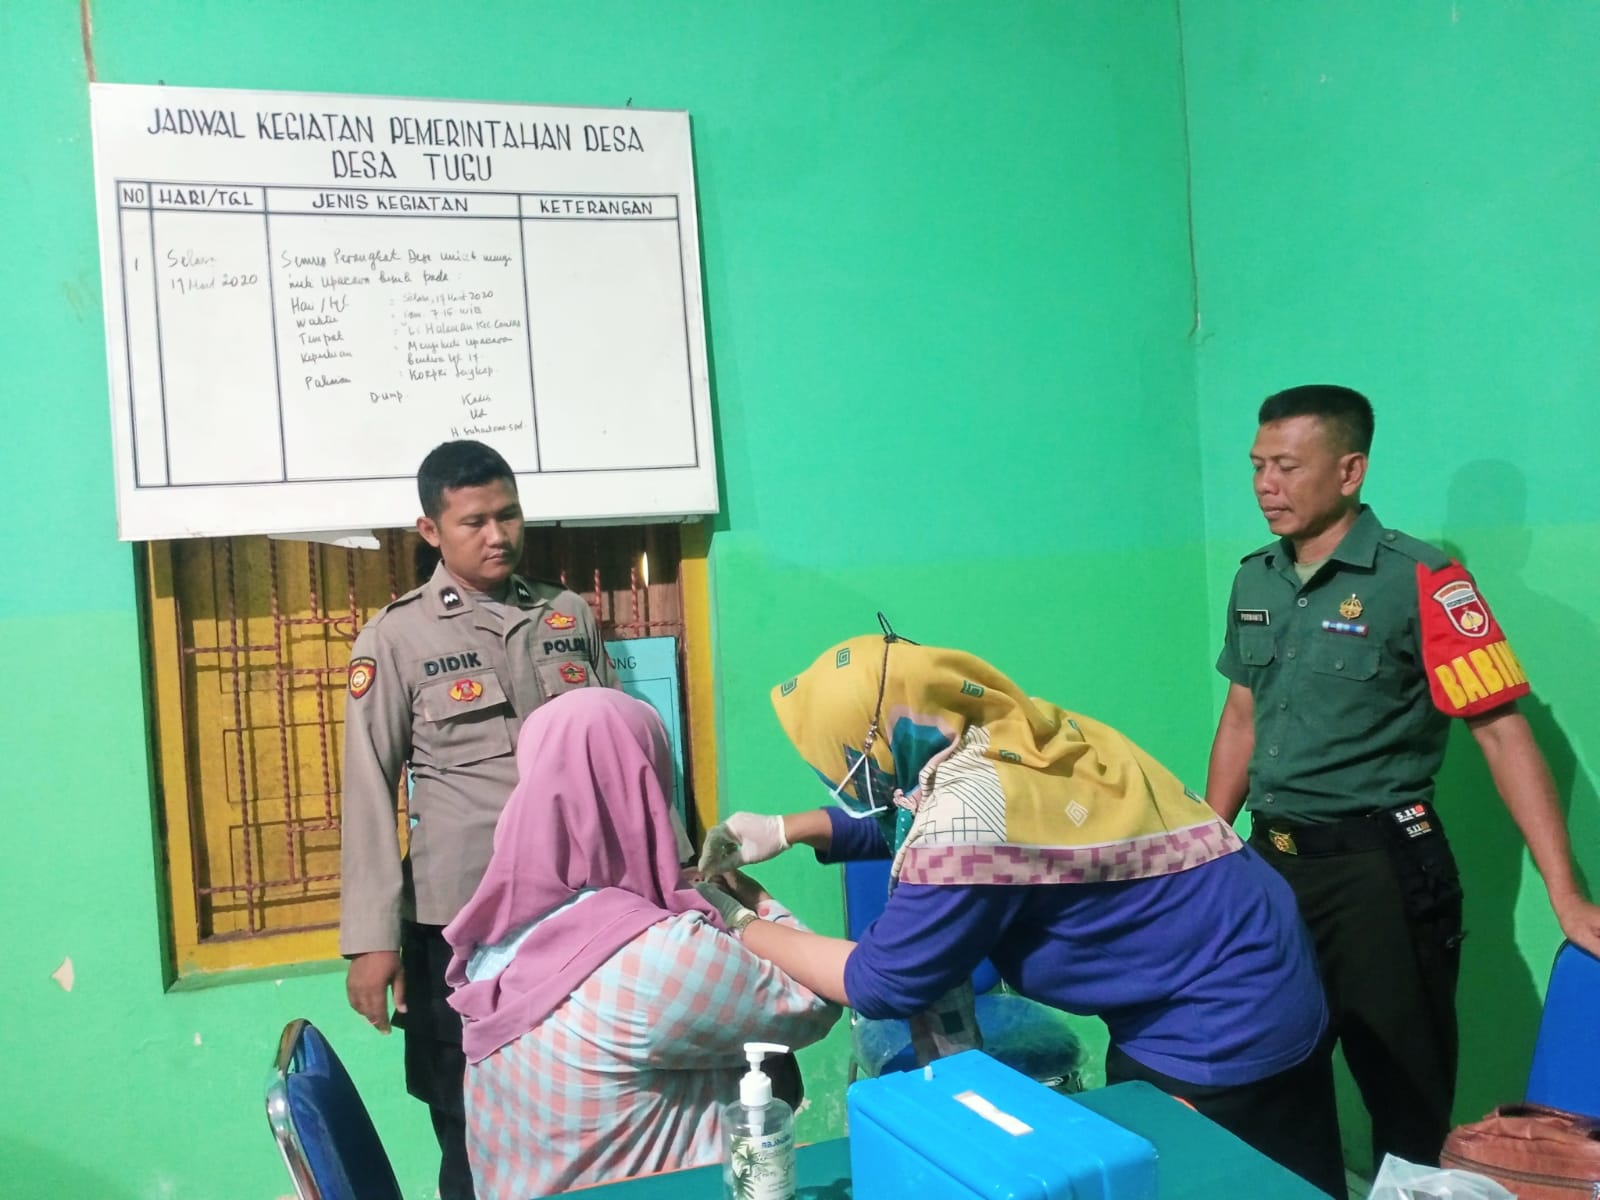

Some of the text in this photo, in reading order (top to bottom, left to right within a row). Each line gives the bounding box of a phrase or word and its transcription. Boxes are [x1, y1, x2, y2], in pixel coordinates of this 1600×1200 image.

[147, 107, 644, 152] JADWAL KEGIATAN PEMERINTAHAN DESA
[332, 150, 492, 182] DESA TUGU
[123, 188, 145, 204] NO
[159, 188, 254, 207] HARI/TGL
[312, 193, 468, 212] JENIS KEGIATAN
[540, 199, 653, 216] KETERANGAN
[222, 273, 258, 287] 2020
[424, 652, 482, 677] DIDIK
